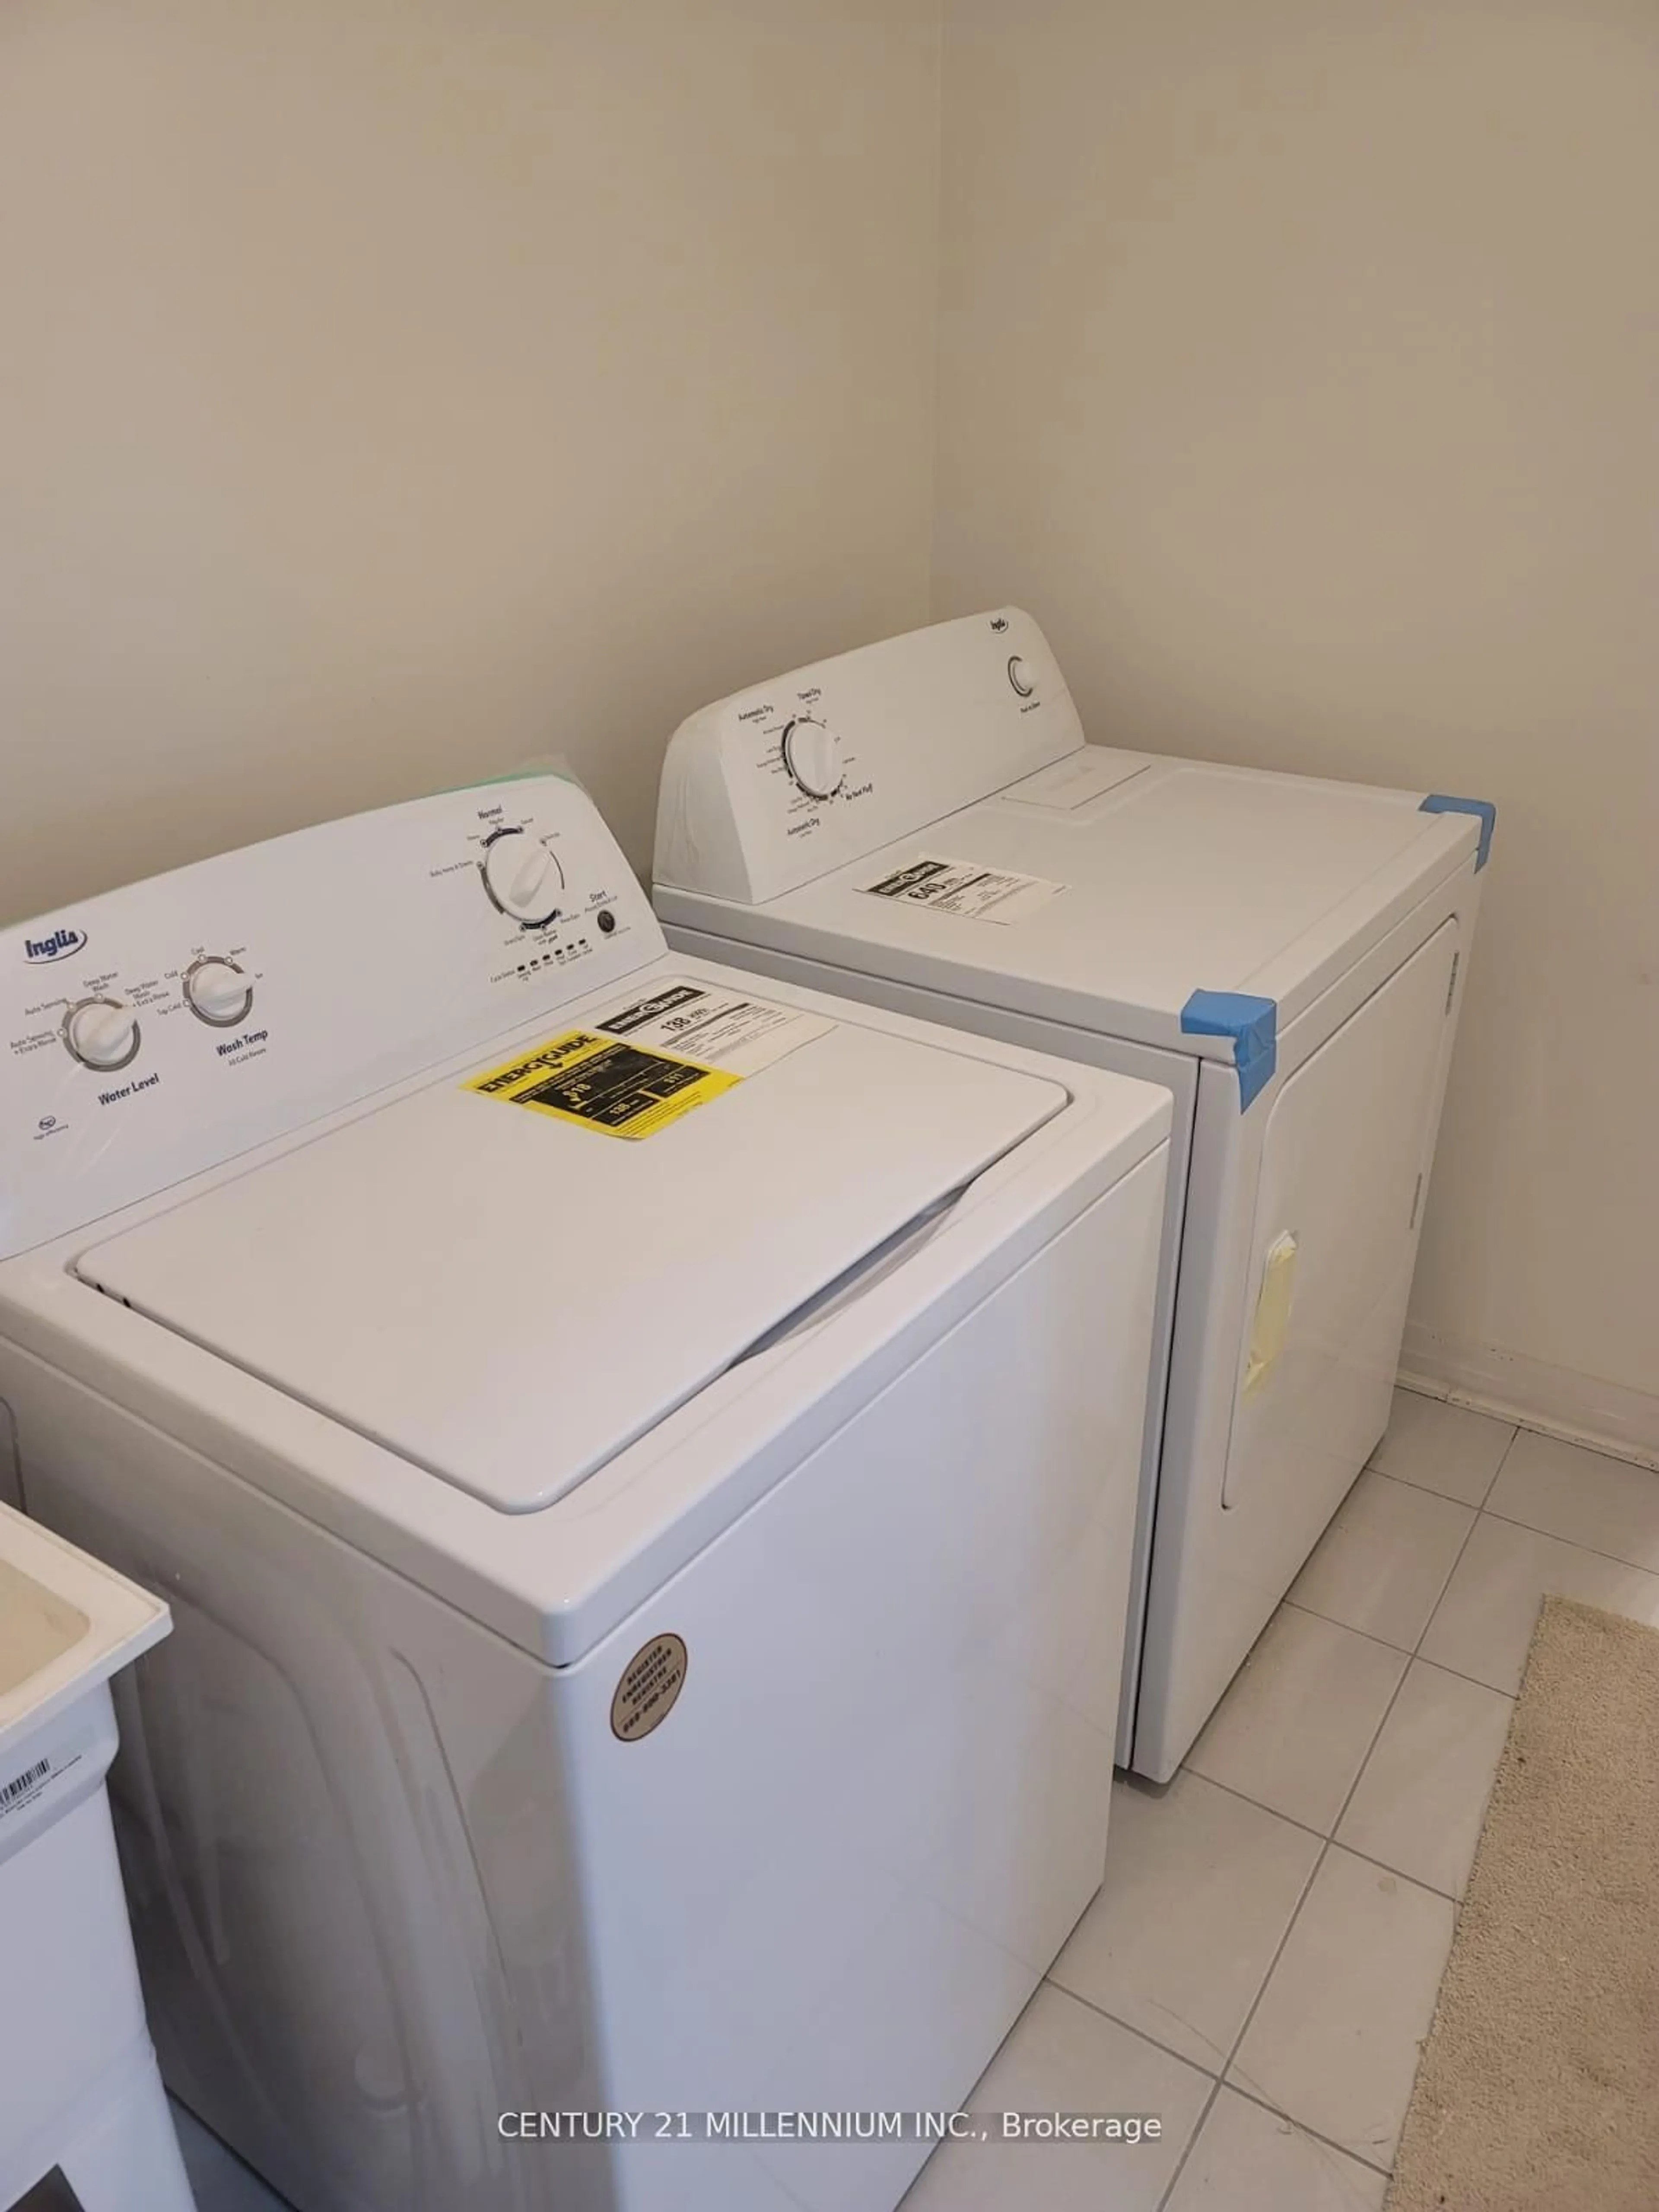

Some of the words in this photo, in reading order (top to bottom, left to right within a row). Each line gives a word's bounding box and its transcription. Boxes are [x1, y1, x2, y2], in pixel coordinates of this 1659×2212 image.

[478, 804, 502, 819] Normal
[589, 890, 607, 903] Start
[25, 929, 78, 958] Inglis
[660, 1017, 692, 1032] 138
[217, 1039, 244, 1057] Wash
[242, 1029, 269, 1045] Temp
[98, 1087, 130, 1106] Water
[130, 1072, 160, 1092] Level
